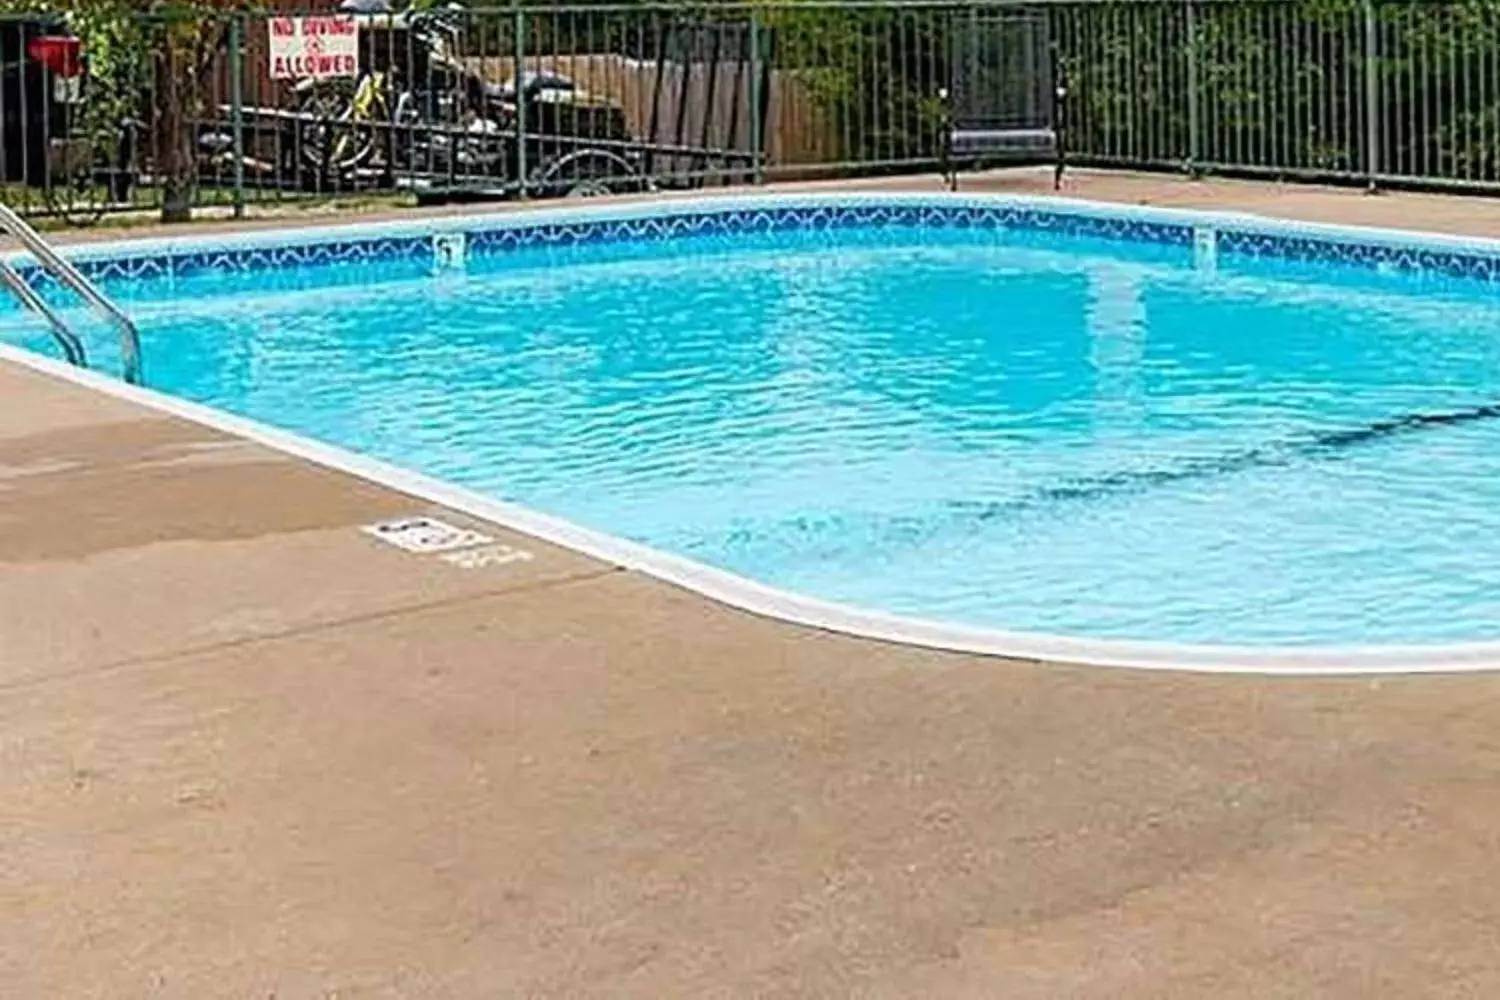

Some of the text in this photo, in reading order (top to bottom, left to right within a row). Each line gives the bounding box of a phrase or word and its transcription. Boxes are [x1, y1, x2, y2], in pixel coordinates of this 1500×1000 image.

[273, 16, 355, 36] NO DIVING
[274, 55, 355, 74] ALLOWED
